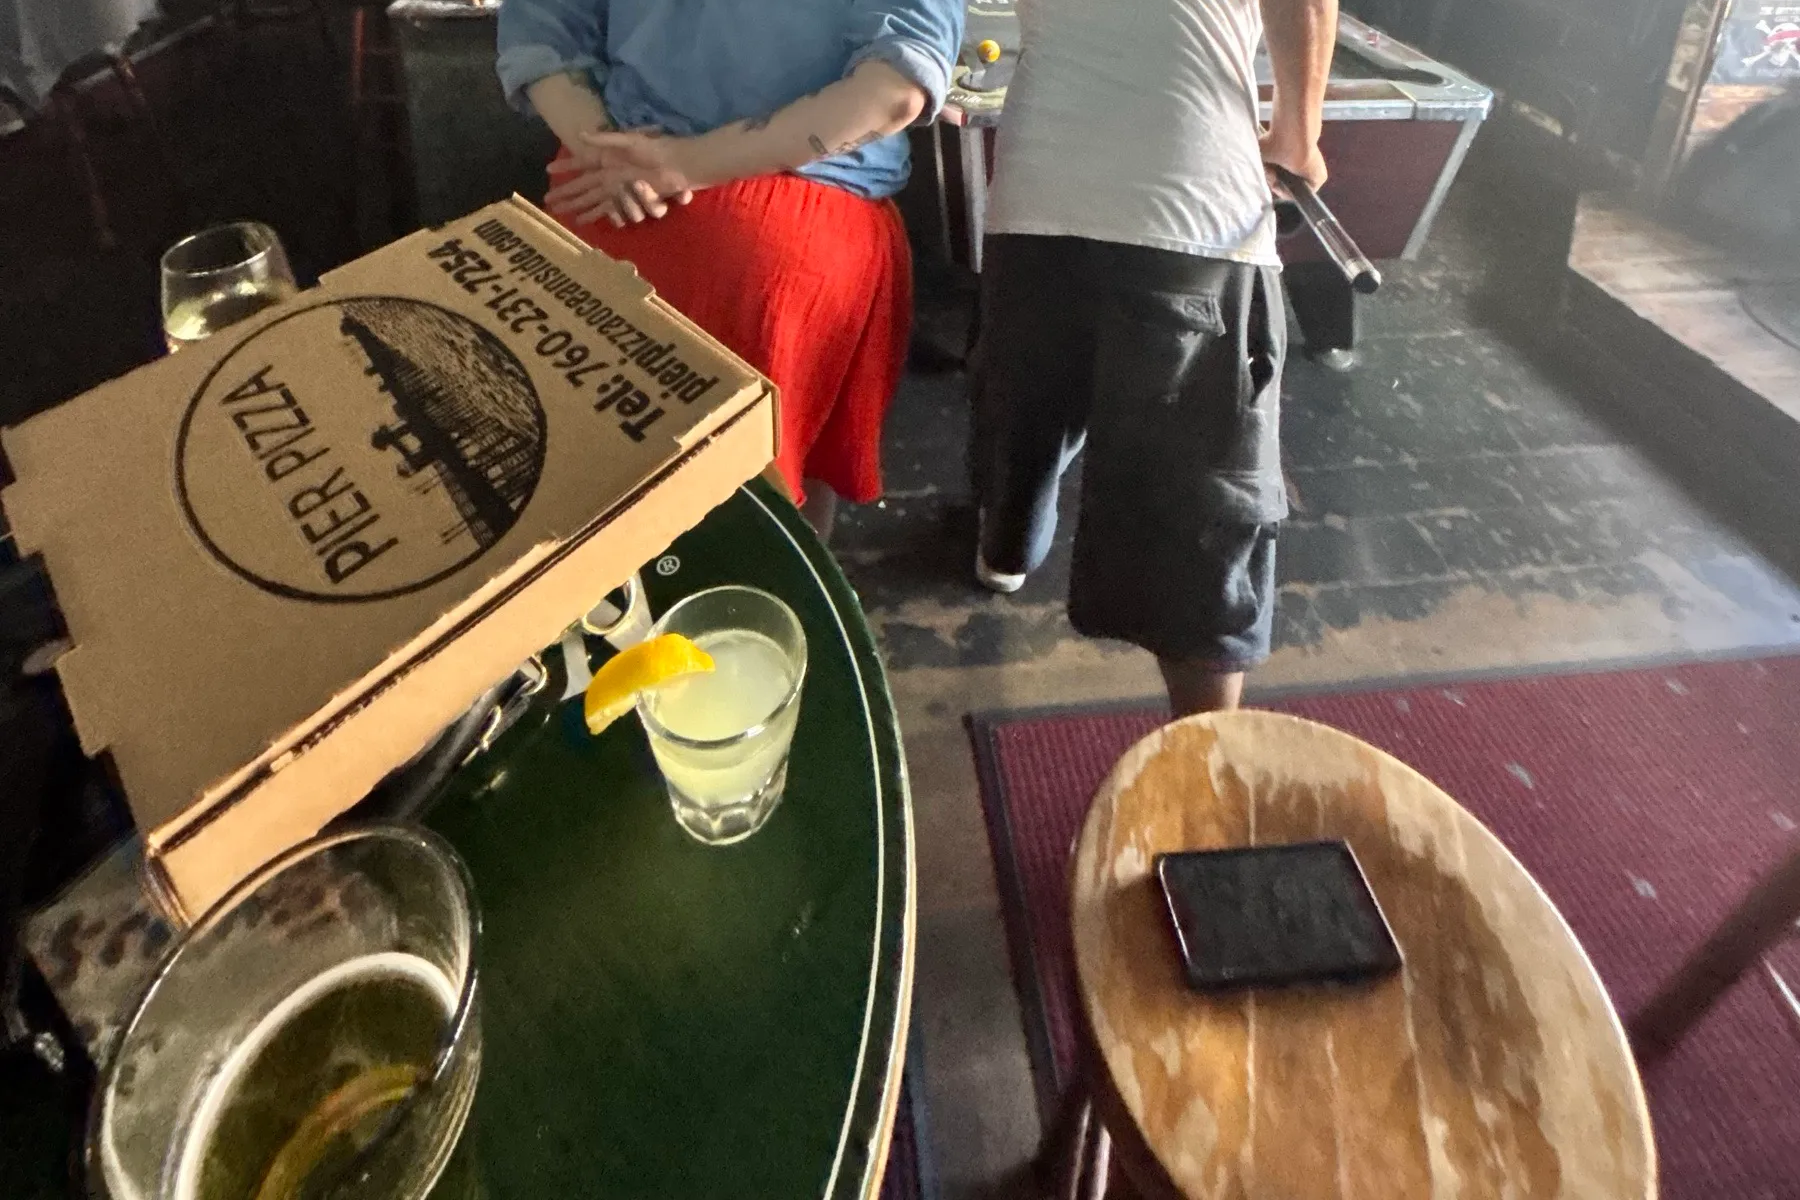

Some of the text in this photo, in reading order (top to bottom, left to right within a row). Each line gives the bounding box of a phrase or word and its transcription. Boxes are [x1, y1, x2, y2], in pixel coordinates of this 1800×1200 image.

[427, 238, 666, 443] Tel: 760-231-7254
[472, 218, 720, 405] pierpizzaoceanside.com
[219, 364, 399, 584] PIER PIZZA
